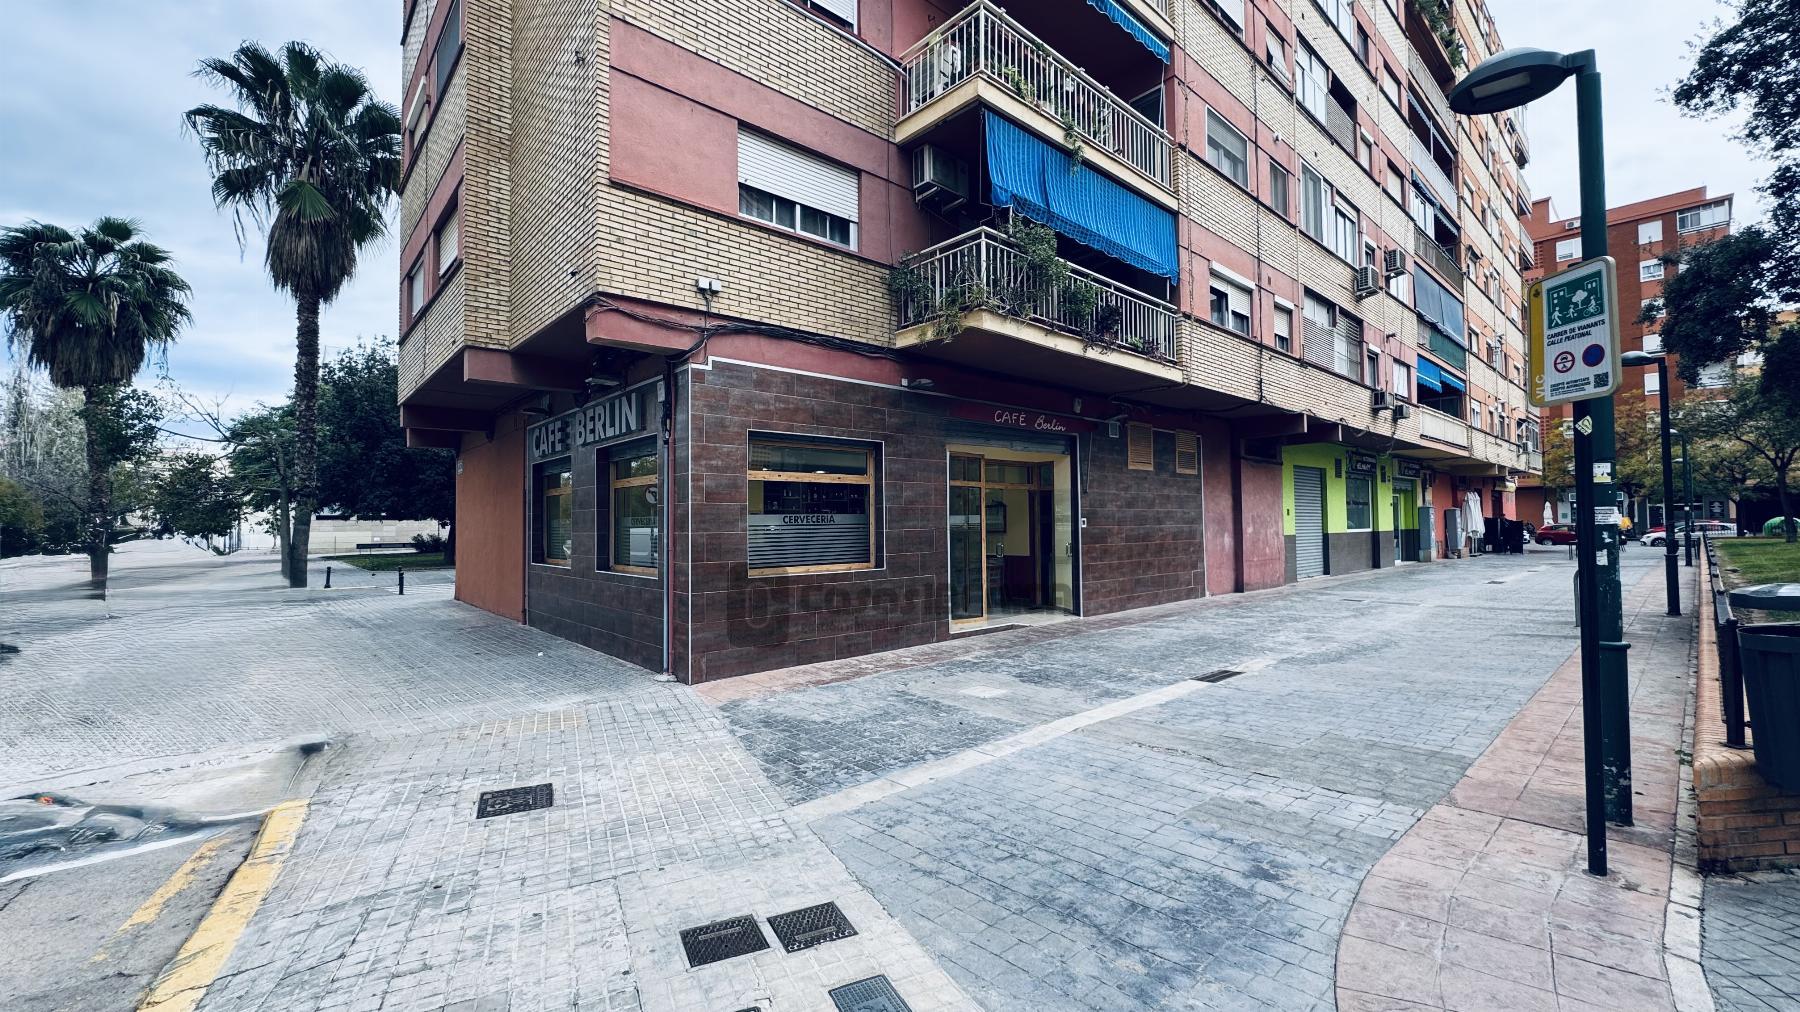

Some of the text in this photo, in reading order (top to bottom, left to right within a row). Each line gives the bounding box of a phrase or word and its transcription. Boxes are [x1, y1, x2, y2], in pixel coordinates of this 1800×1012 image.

[1547, 319, 1605, 340] CARRER DE VIANANTS
[1547, 330, 1592, 346] CALLE PEATONAL
[1535, 374, 1545, 399] VLC
[575, 392, 636, 445] BERLIN
[1034, 415, 1066, 432] Berlin
[782, 514, 836, 525] CERVECERIA
